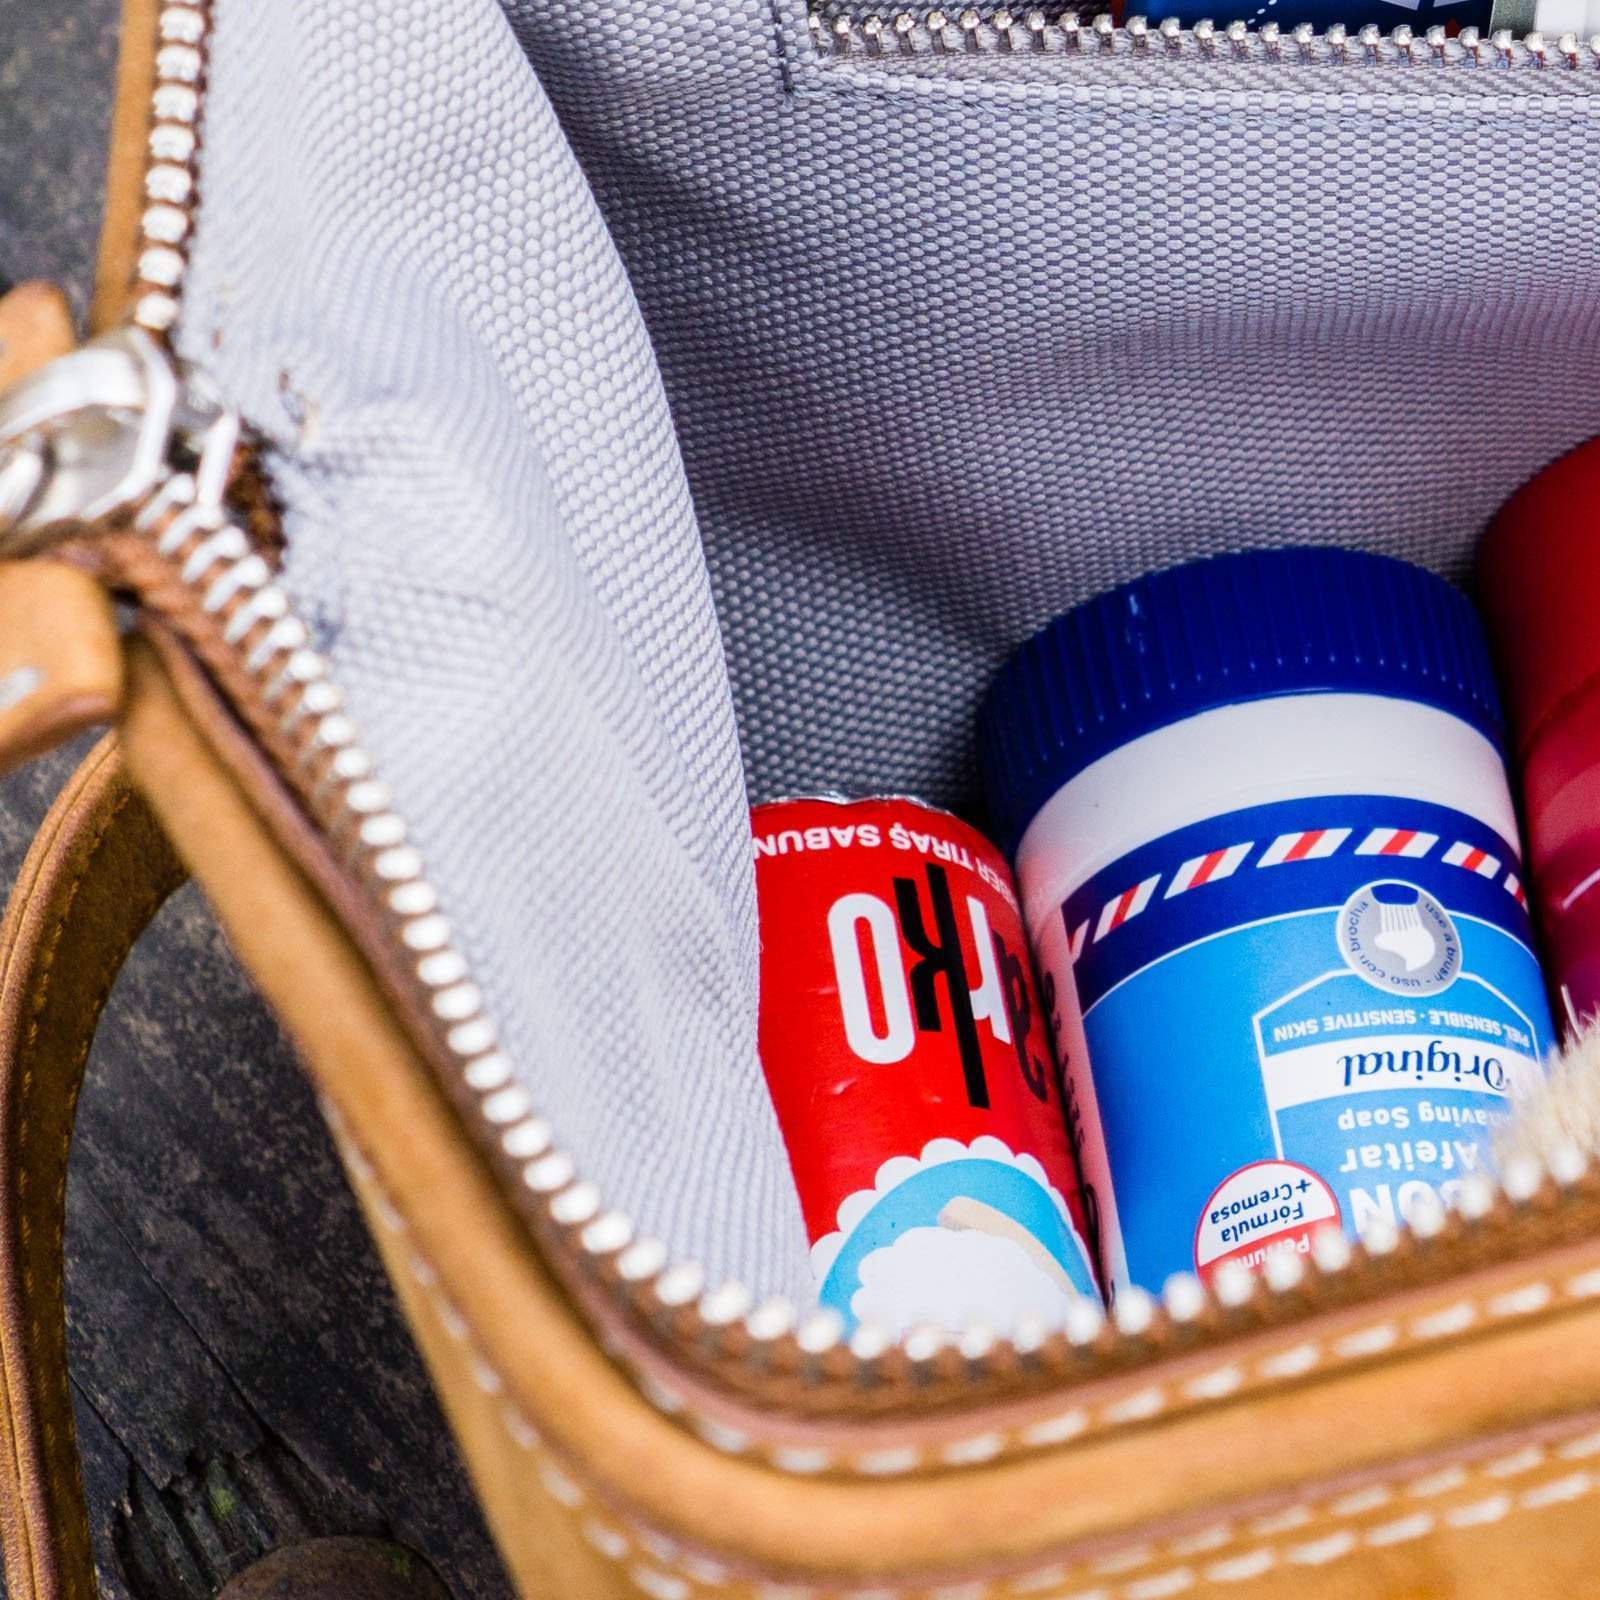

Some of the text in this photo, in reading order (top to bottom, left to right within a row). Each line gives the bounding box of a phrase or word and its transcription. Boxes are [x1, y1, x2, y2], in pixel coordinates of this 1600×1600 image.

[1423, 902, 1448, 930] use
[1433, 946, 1458, 983] brush
[1272, 1022, 1319, 1043] SKIN
[1322, 1008, 1417, 1032] SENSITIVE
[1428, 1009, 1503, 1036] SENSIBLE
[1336, 1039, 1511, 1093] Original
[1336, 1103, 1411, 1132] Soap
[1338, 1138, 1480, 1174] Afeitar
[1220, 1201, 1305, 1243] Fórmula
